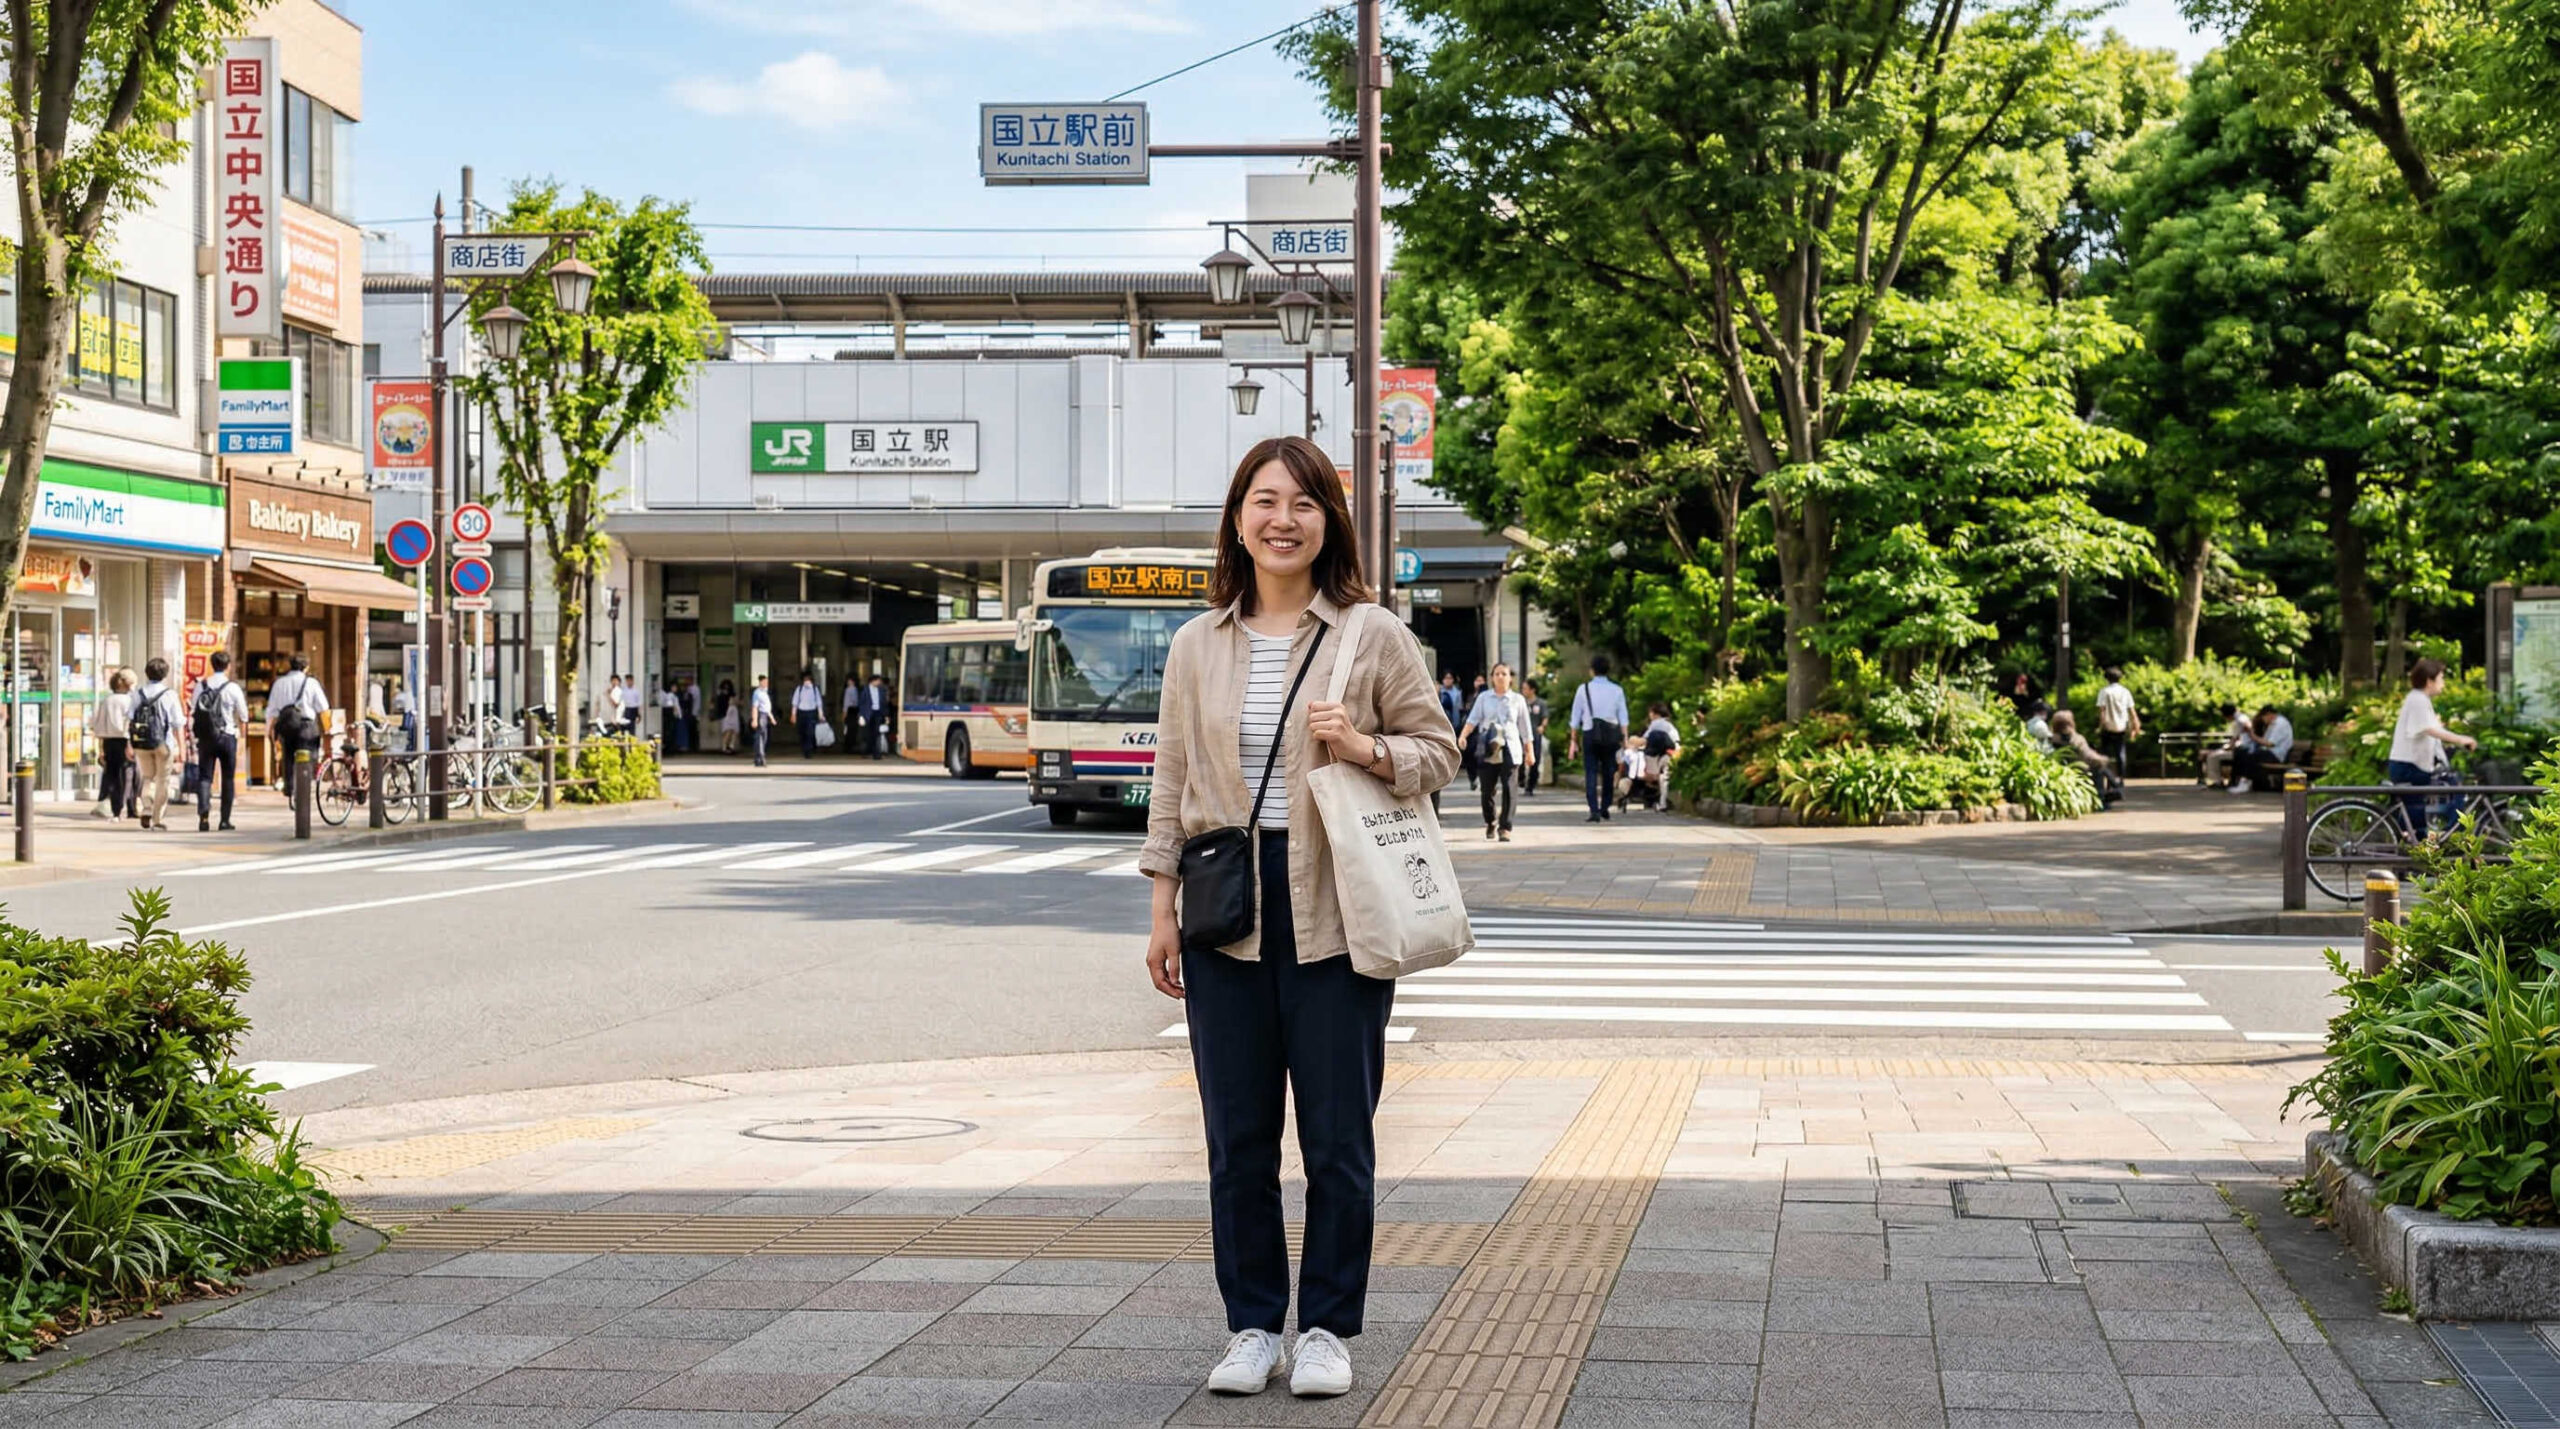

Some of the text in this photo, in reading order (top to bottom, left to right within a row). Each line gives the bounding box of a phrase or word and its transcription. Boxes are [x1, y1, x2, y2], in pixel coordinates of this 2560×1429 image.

[992, 113, 1135, 147] 国立駅前
[997, 152, 1131, 166] Kunitachi Station
[225, 59, 263, 318] 国立中央通り
[1272, 228, 1348, 254] 商店街
[450, 243, 526, 268] 商店街
[221, 400, 290, 414] FamilyMart
[765, 429, 812, 456] JR
[852, 428, 949, 452] 国立駅
[851, 456, 951, 467] Kunitachi Station
[45, 492, 124, 527] FamilyMart
[311, 509, 362, 549] Bakery
[462, 514, 484, 532] 30
[1088, 566, 1208, 589] 国立駅南口
